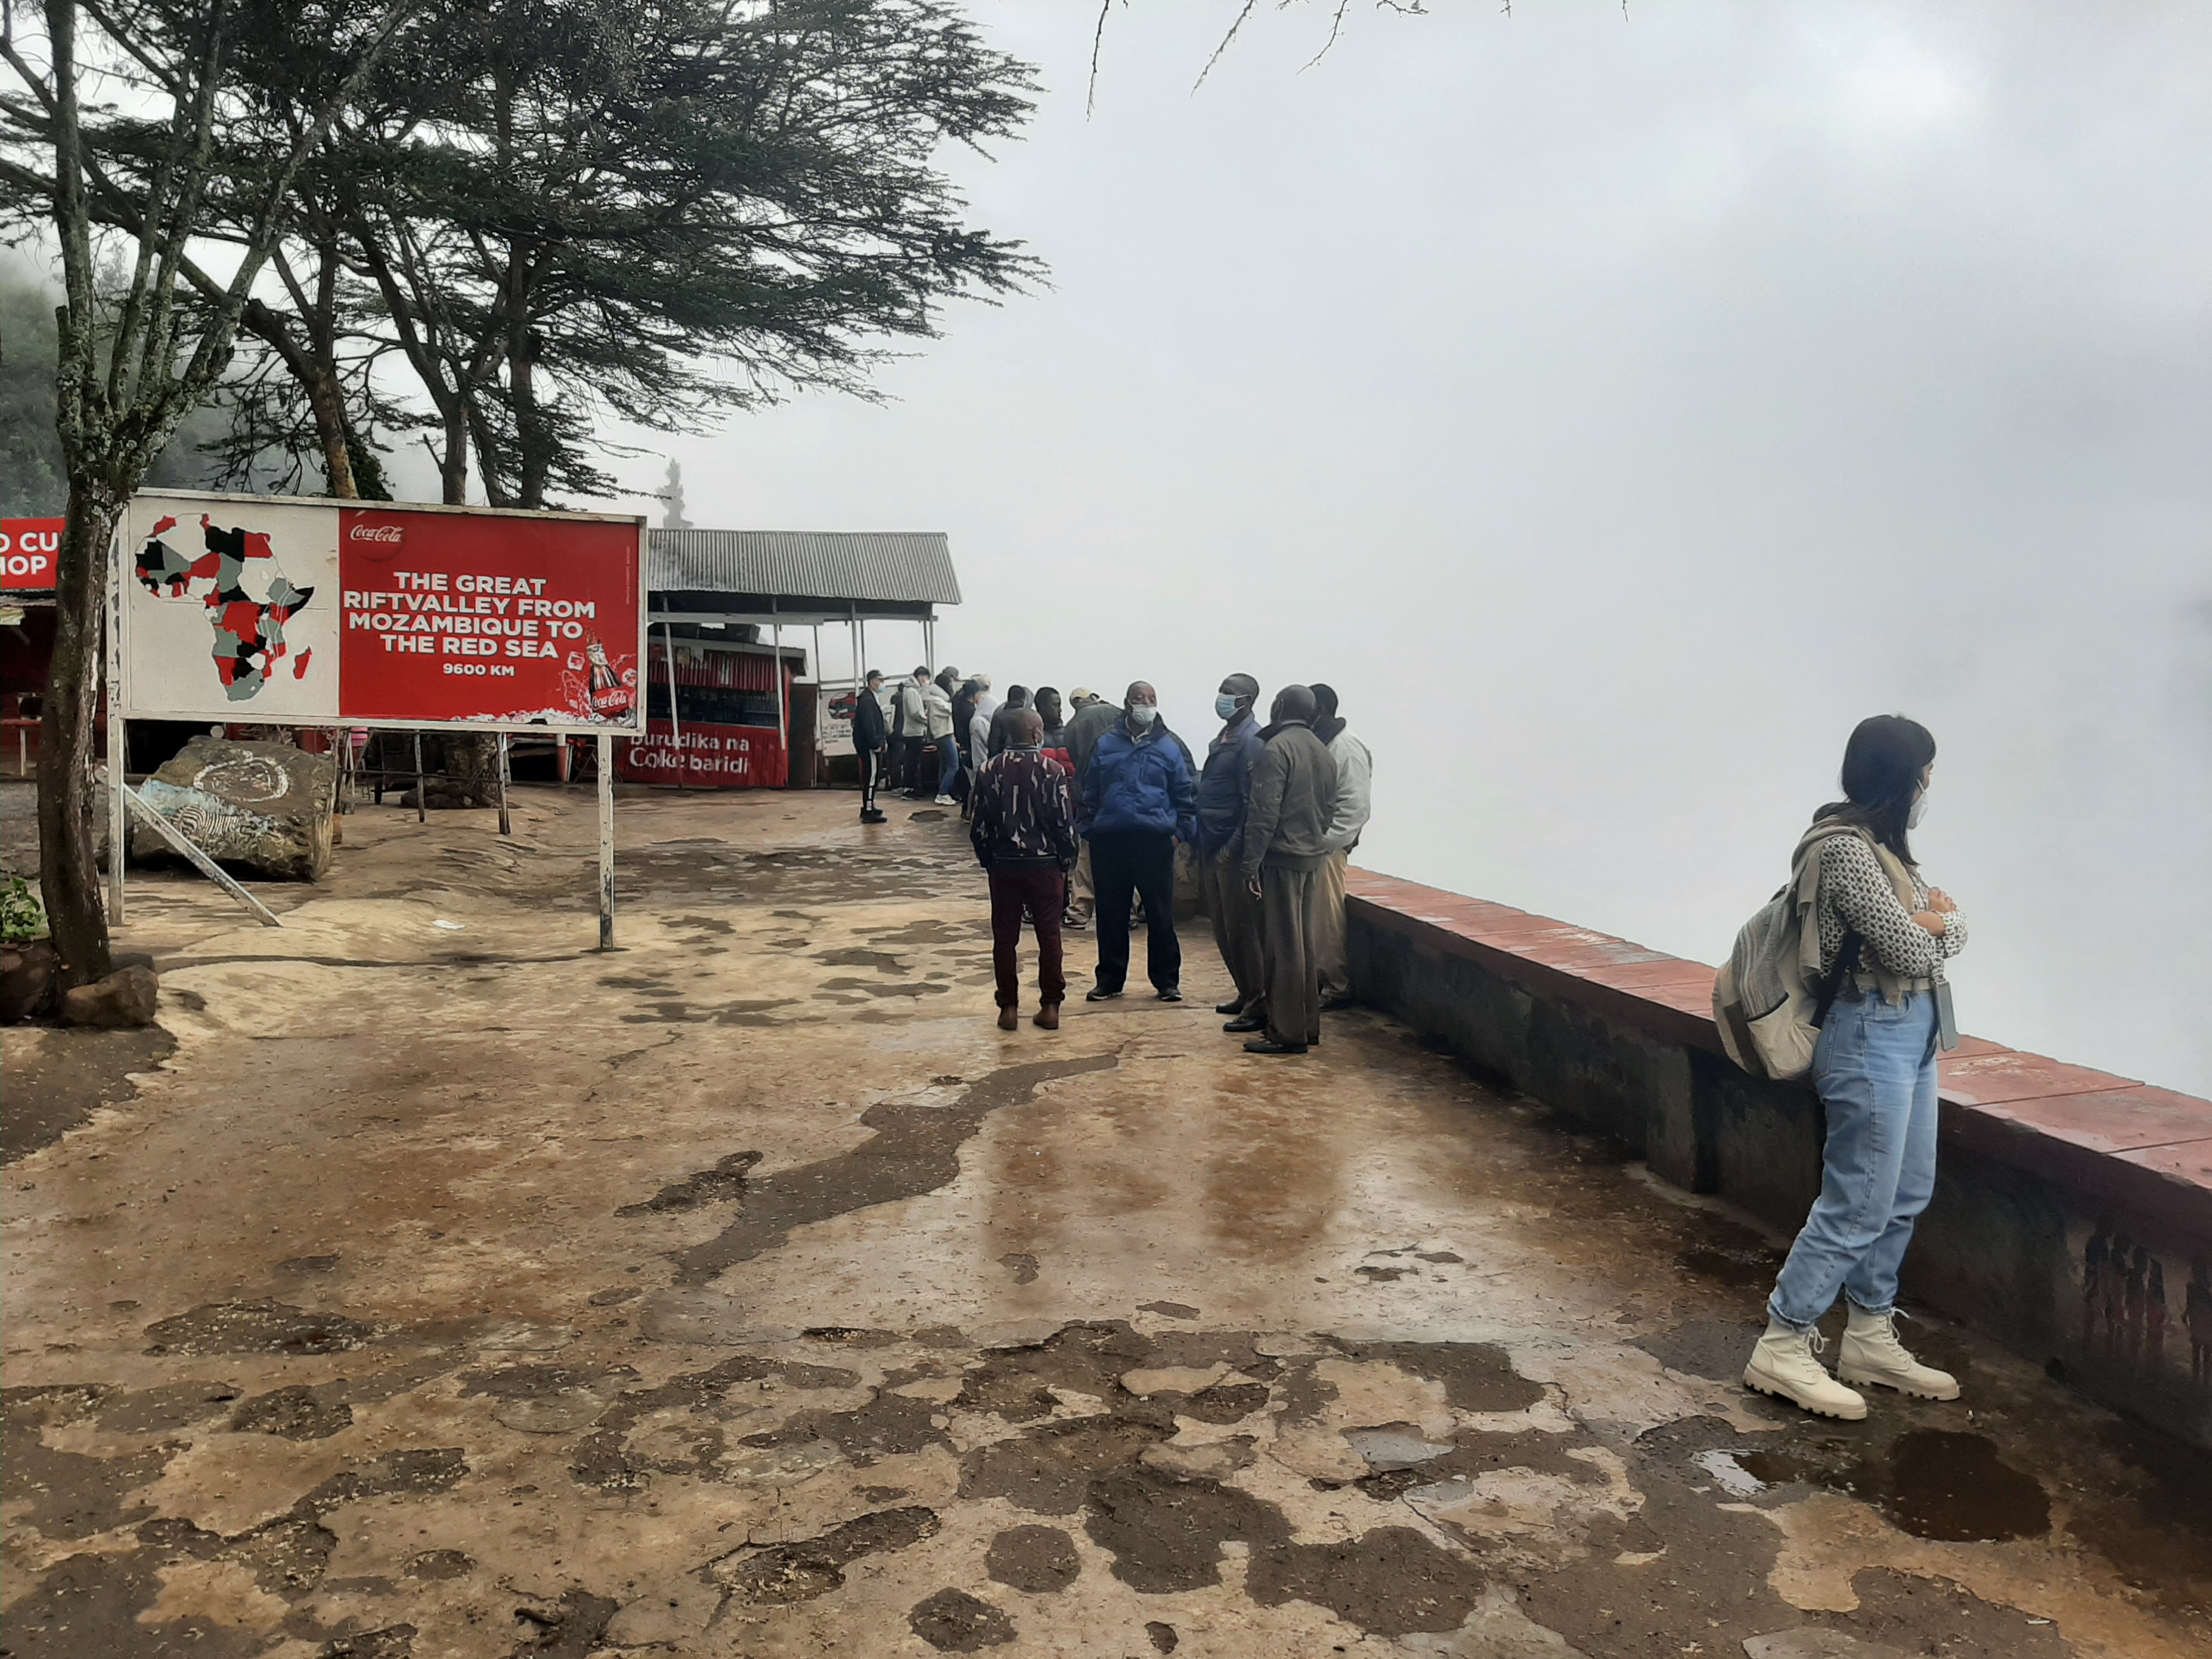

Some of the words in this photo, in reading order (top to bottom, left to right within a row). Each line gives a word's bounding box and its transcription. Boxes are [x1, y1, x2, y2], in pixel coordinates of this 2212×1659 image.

[393, 572, 448, 591] THE
[455, 574, 547, 596] GREAT
[343, 590, 511, 615] RIFTVALLEY
[517, 598, 595, 619] FROM
[349, 612, 539, 637] MOZAMBIQUE
[545, 620, 583, 639] TO
[380, 634, 435, 653] THE
[442, 636, 498, 656] RED
[504, 639, 559, 658] SEA
[443, 663, 486, 675] 9600
[490, 665, 515, 676] KM
[726, 737, 749, 752] na
[629, 747, 685, 768] Coke
[689, 754, 748, 774] baridi
